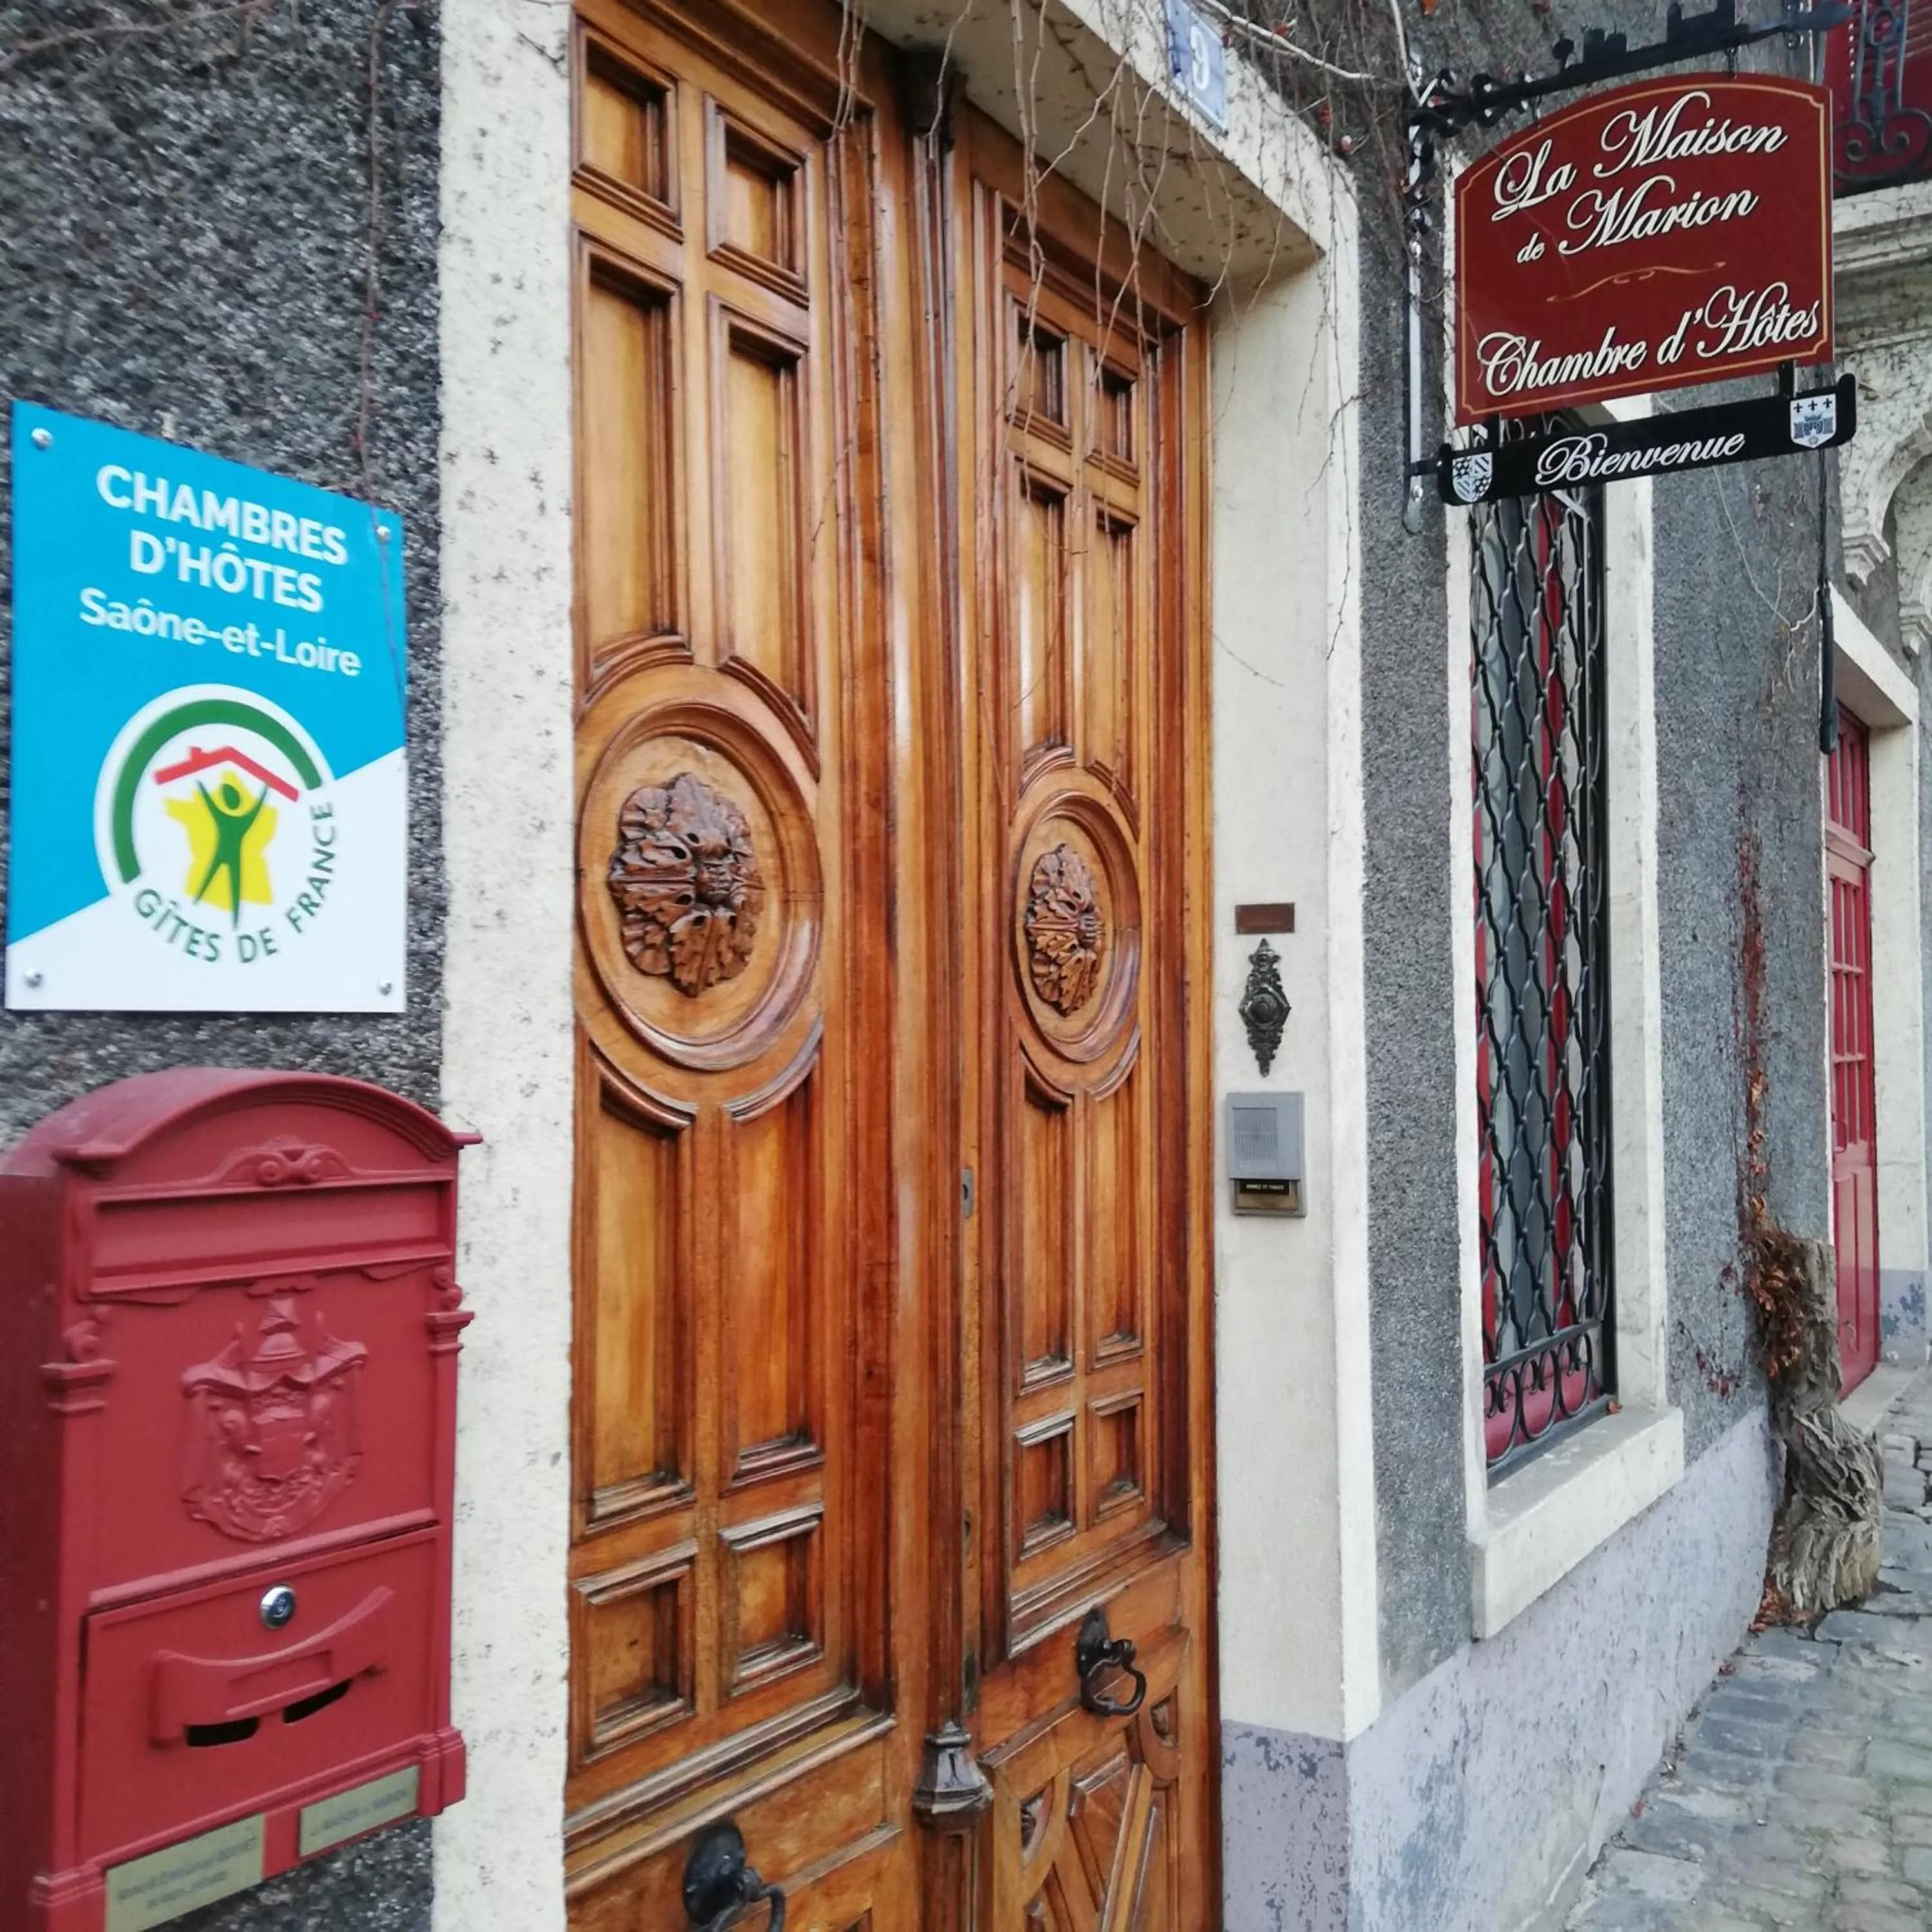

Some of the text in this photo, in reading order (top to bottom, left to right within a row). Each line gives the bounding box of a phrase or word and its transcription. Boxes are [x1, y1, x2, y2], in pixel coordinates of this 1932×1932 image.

[1490, 90, 1788, 222] La Maison
[1516, 175, 1759, 263] de Marion
[1476, 280, 1819, 397] Chambre d'Hôtes
[1535, 431, 1746, 486] Bienvenue
[96, 464, 348, 565] CHAMBRES
[129, 528, 323, 613] D'HÔTES
[79, 587, 363, 676] Saône-et-Loire
[133, 800, 338, 964] GÎTES DE FRANCE
